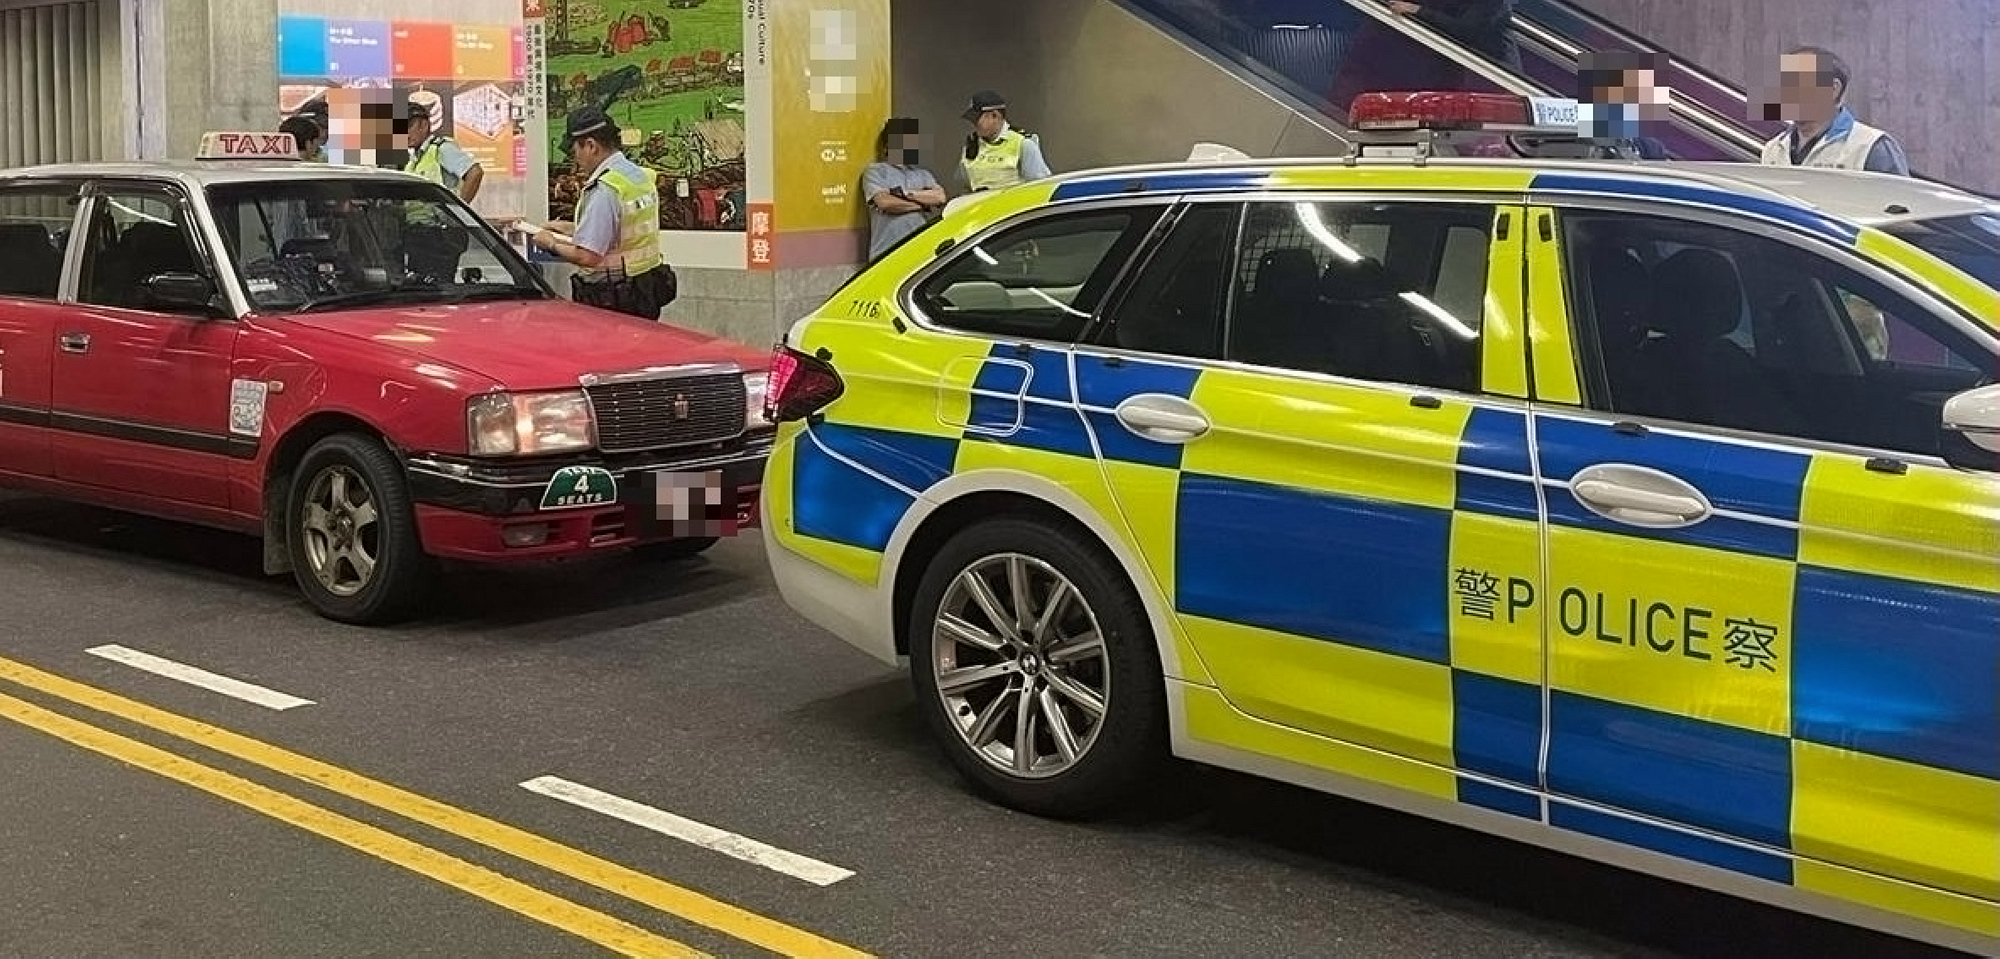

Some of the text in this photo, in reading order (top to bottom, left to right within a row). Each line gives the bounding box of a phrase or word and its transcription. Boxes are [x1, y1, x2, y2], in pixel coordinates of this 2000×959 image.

[757, 23, 766, 65] Culture
[220, 133, 292, 155] TAXI
[752, 211, 770, 263] 摩登
[558, 492, 603, 505] SEATS
[574, 475, 589, 493] 4
[1454, 567, 1501, 621] 警
[1723, 617, 1779, 673] 察
